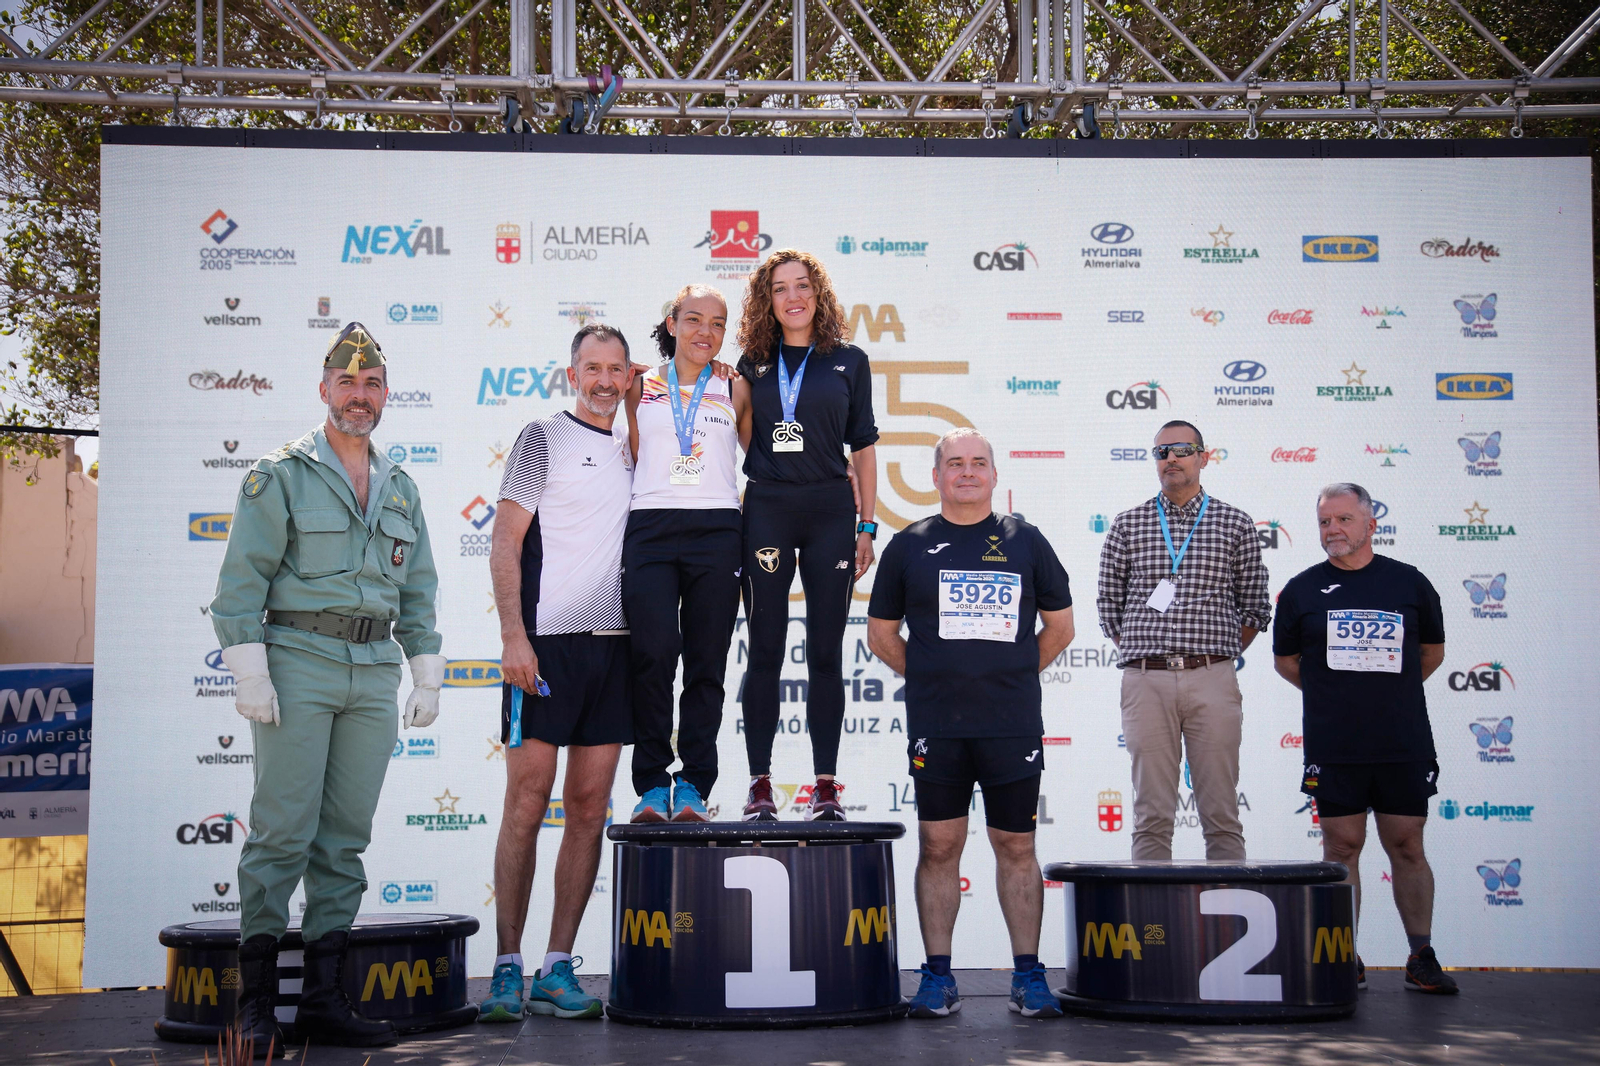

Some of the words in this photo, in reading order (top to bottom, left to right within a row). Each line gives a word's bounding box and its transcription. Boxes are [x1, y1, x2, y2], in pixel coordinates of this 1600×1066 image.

[543, 222, 650, 246] ALMERÍA
[341, 219, 451, 263] NEXAL
[861, 237, 929, 255] cajamar
[200, 247, 295, 260] COOPERACIÓN
[543, 248, 597, 261] CIUDAD
[1081, 248, 1142, 258] HYUNDAI
[1183, 248, 1260, 258] ESTRELLA
[1312, 243, 1371, 254] IKEA
[200, 260, 232, 270] 2005
[973, 251, 1025, 271] CASI
[1084, 259, 1140, 268] Almerialva
[204, 314, 261, 326] vellsam
[1108, 311, 1144, 323] SER
[1214, 386, 1274, 395] HYUNDAI
[1316, 386, 1393, 396] ESTRELLA
[1446, 381, 1505, 392] IKEA
[387, 390, 431, 402] RACIÓN
[1106, 389, 1157, 409] CASI
[1216, 397, 1273, 406] Almerialva
[704, 416, 730, 426] VARGAS
[411, 446, 437, 454] SAFA
[1111, 448, 1147, 460] SER
[200, 521, 228, 533] IK
[1439, 525, 1516, 535] ESTRELLA
[1258, 530, 1278, 549] SI
[460, 547, 491, 556] 2005
[949, 584, 1012, 605] 5926
[1336, 621, 1396, 640] 5922
[1050, 646, 1119, 668] MERÍA
[194, 676, 237, 686] HYUN
[1448, 671, 1500, 691] CASI
[196, 688, 237, 697] Almeri
[27, 728, 92, 743] Marat
[408, 738, 435, 747] SAFA
[0, 743, 91, 777] merí
[196, 753, 254, 765] vellsam
[1465, 801, 1534, 820] cajamar
[406, 814, 487, 825] ESTRELLA
[177, 822, 234, 845] CASI
[406, 884, 433, 892] SAFA
[674, 912, 693, 927] 25
[724, 855, 816, 1008] 1
[1144, 924, 1165, 939] 25
[1199, 888, 1282, 1002] 2
[435, 956, 449, 972] 25
[221, 968, 240, 984] 25
